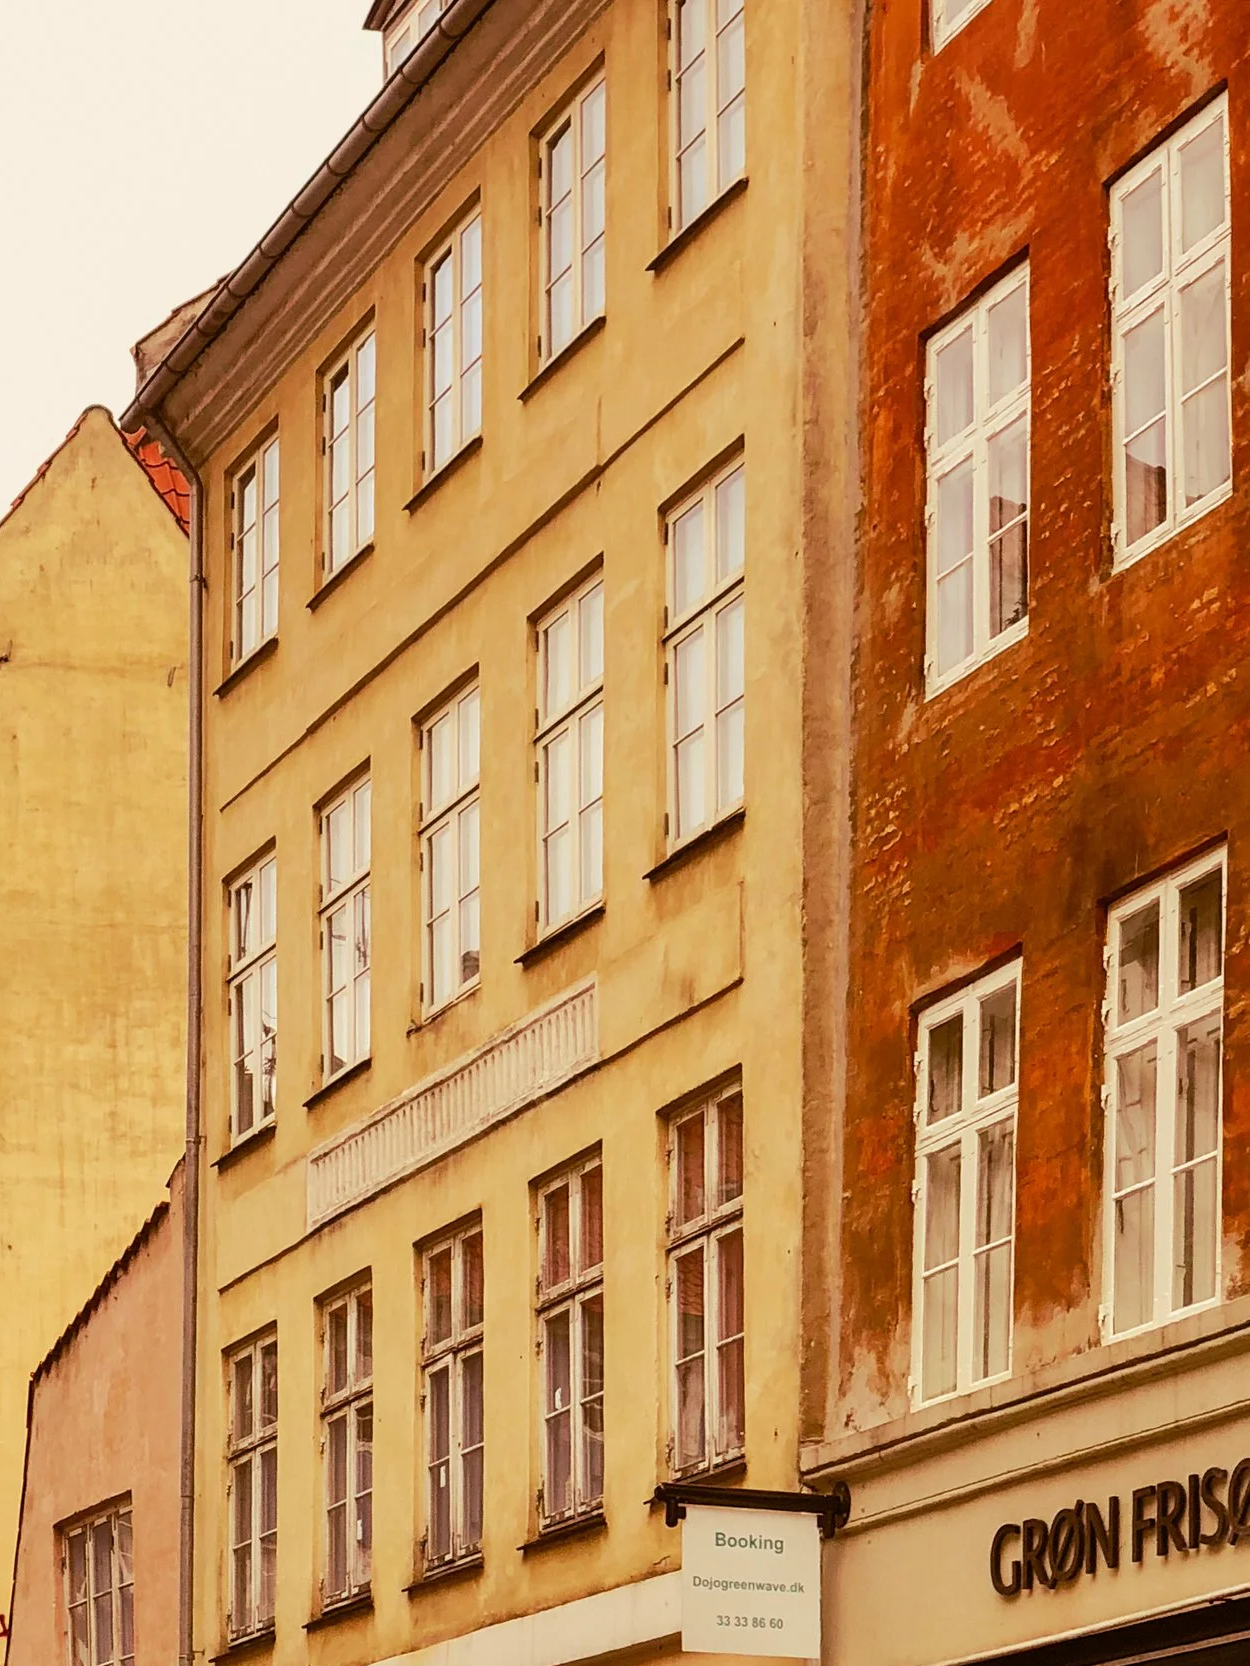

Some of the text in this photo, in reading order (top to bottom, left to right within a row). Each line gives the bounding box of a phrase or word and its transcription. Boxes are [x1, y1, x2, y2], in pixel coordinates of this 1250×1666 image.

[715, 1531, 784, 1554] Booking
[990, 1496, 1120, 1598] GRØN
[692, 1575, 805, 1593] Dojogreenwave.dk
[716, 1614, 784, 1630] 33 33 86 60
